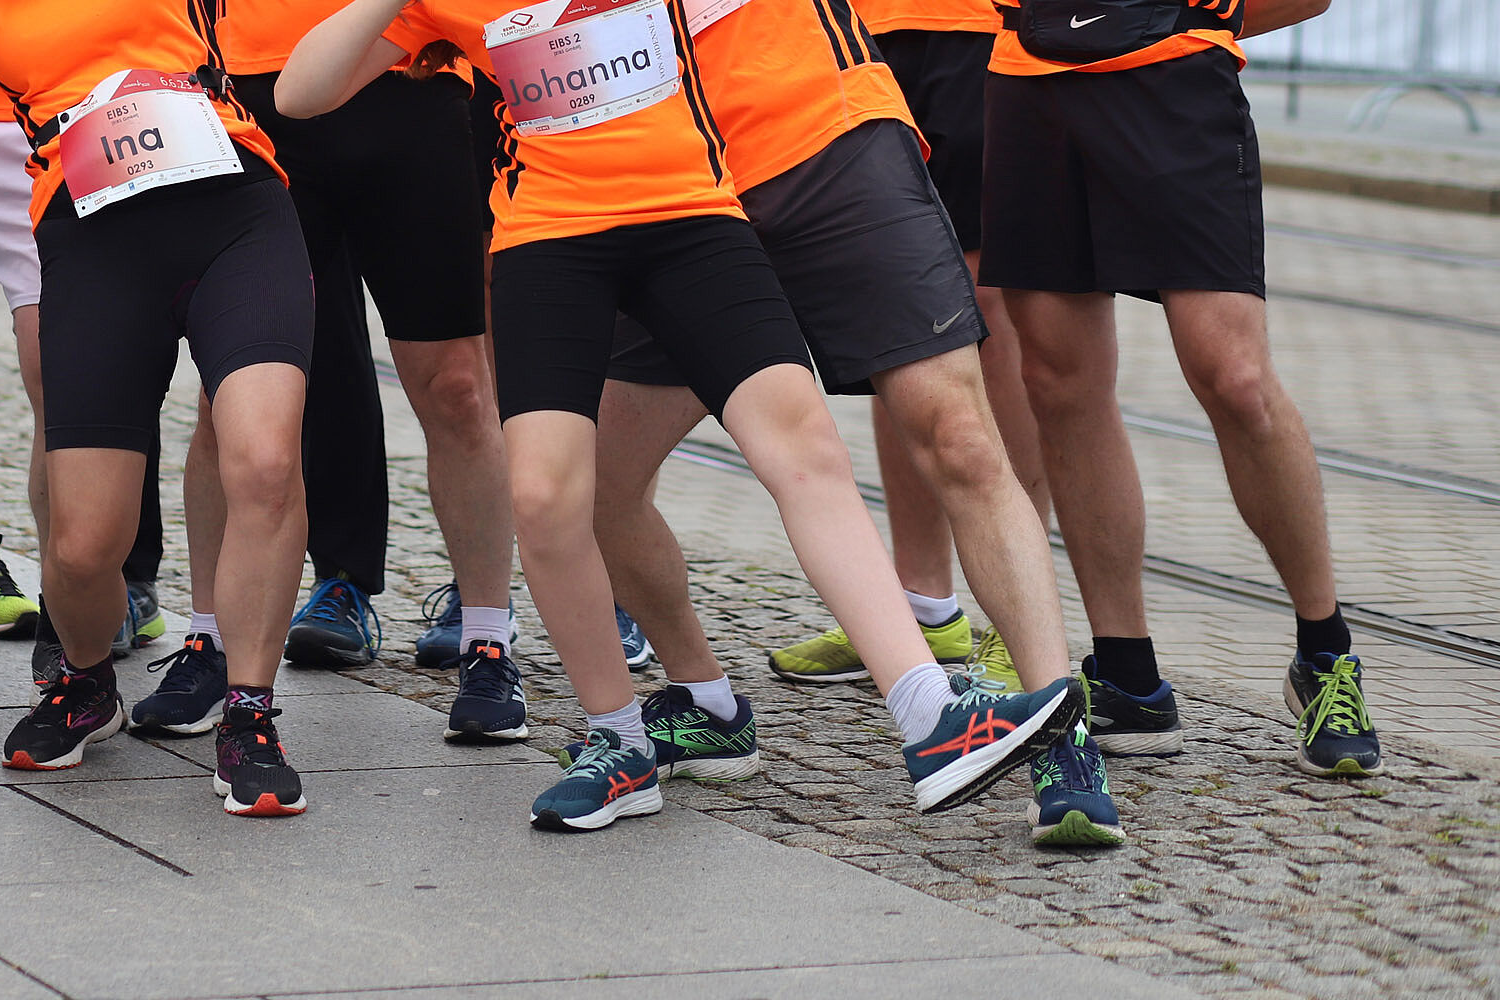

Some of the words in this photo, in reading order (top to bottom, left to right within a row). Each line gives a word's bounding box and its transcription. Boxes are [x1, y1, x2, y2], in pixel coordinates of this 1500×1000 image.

[549, 35, 572, 51] EIBS
[574, 33, 582, 44] 2
[159, 76, 193, 90] 6.6.23
[509, 47, 652, 107] Johanna
[569, 93, 596, 110] 0289
[106, 107, 129, 121] EIBS
[132, 102, 139, 113] 1
[100, 127, 165, 165] Ina
[126, 160, 155, 176] 0293
